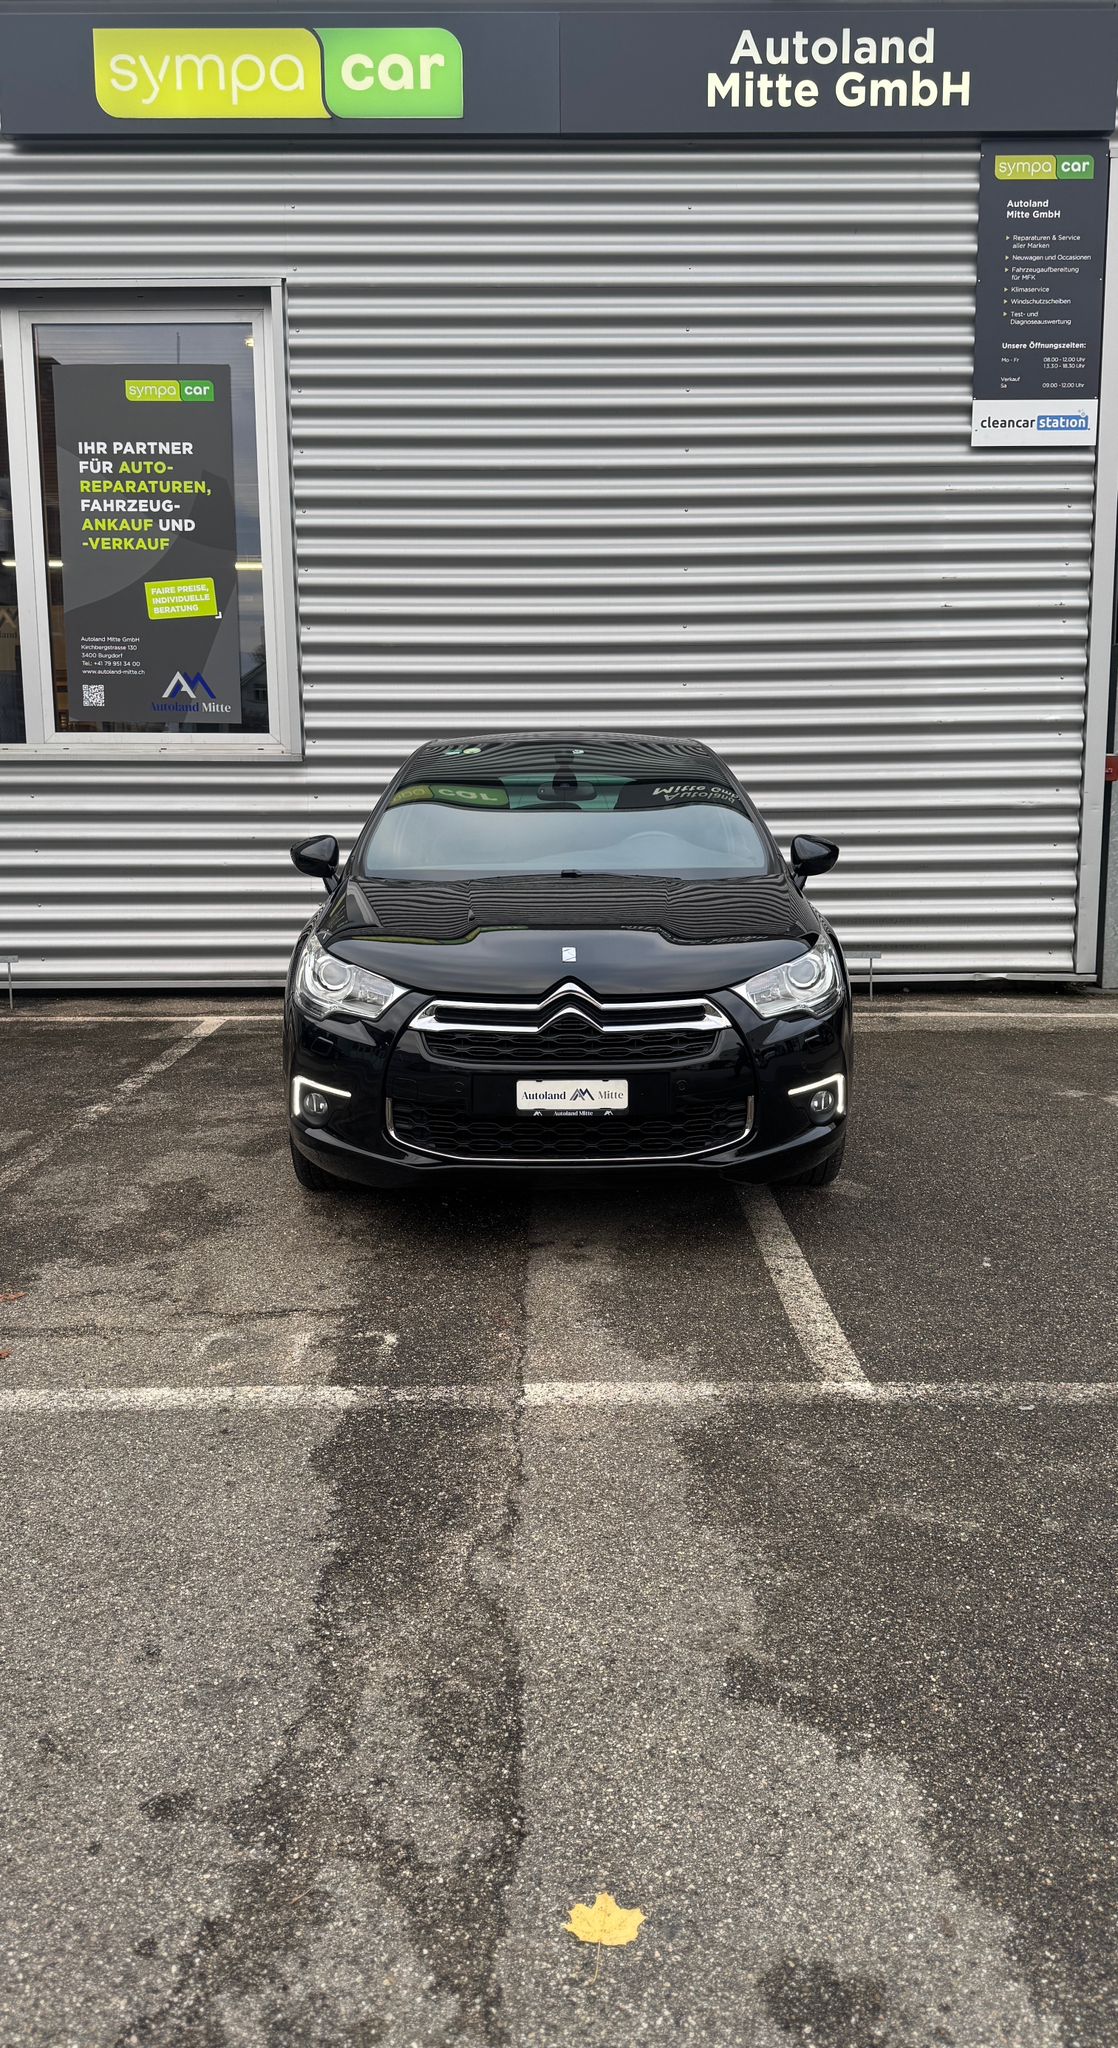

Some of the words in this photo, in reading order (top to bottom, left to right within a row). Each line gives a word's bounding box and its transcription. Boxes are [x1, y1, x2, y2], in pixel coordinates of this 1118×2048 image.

[730, 28, 935, 66] Autoland
[110, 49, 306, 107] sympa
[340, 50, 446, 92] car
[706, 70, 820, 108] Mitte
[836, 70, 972, 108] GmbH
[999, 160, 1053, 176] sympa
[1061, 160, 1090, 173] car
[1006, 199, 1049, 208] Autoland
[1006, 210, 1030, 219] Mitte
[1032, 210, 1061, 219] GmbH
[1013, 234, 1051, 242] Reparaturen
[1012, 254, 1044, 262] Neuwagen
[1011, 266, 1079, 274] Fahrzeugaufbereitung
[1010, 318, 1071, 326] Diagnoseauswertung
[1029, 340, 1087, 351] Öffnungszeiten:
[128, 385, 177, 398] sympa
[184, 385, 210, 395] car
[980, 416, 1036, 429] cleancar
[1039, 416, 1086, 428] station
[78, 441, 108, 455] IHR
[112, 441, 194, 455] PARTNER
[79, 458, 114, 474] FÜR
[118, 461, 174, 474] AUTO-
[80, 480, 212, 496] REPARATUREN,
[80, 499, 181, 513] FAHRZEUG-
[81, 518, 154, 531] ANKAUF
[158, 518, 196, 532] UND
[82, 537, 170, 551] -VERKAUF
[151, 586, 176, 595] FAIRE
[177, 584, 209, 594] PREISE,
[152, 594, 211, 605] INDIVIDUELLE
[153, 604, 199, 615] BERATUNG
[98, 652, 123, 660] Burgdorf
[150, 702, 199, 713] Autoland
[201, 702, 232, 713] Mitte
[521, 1091, 566, 1100] Autoland
[598, 1090, 624, 1099] Mitte
